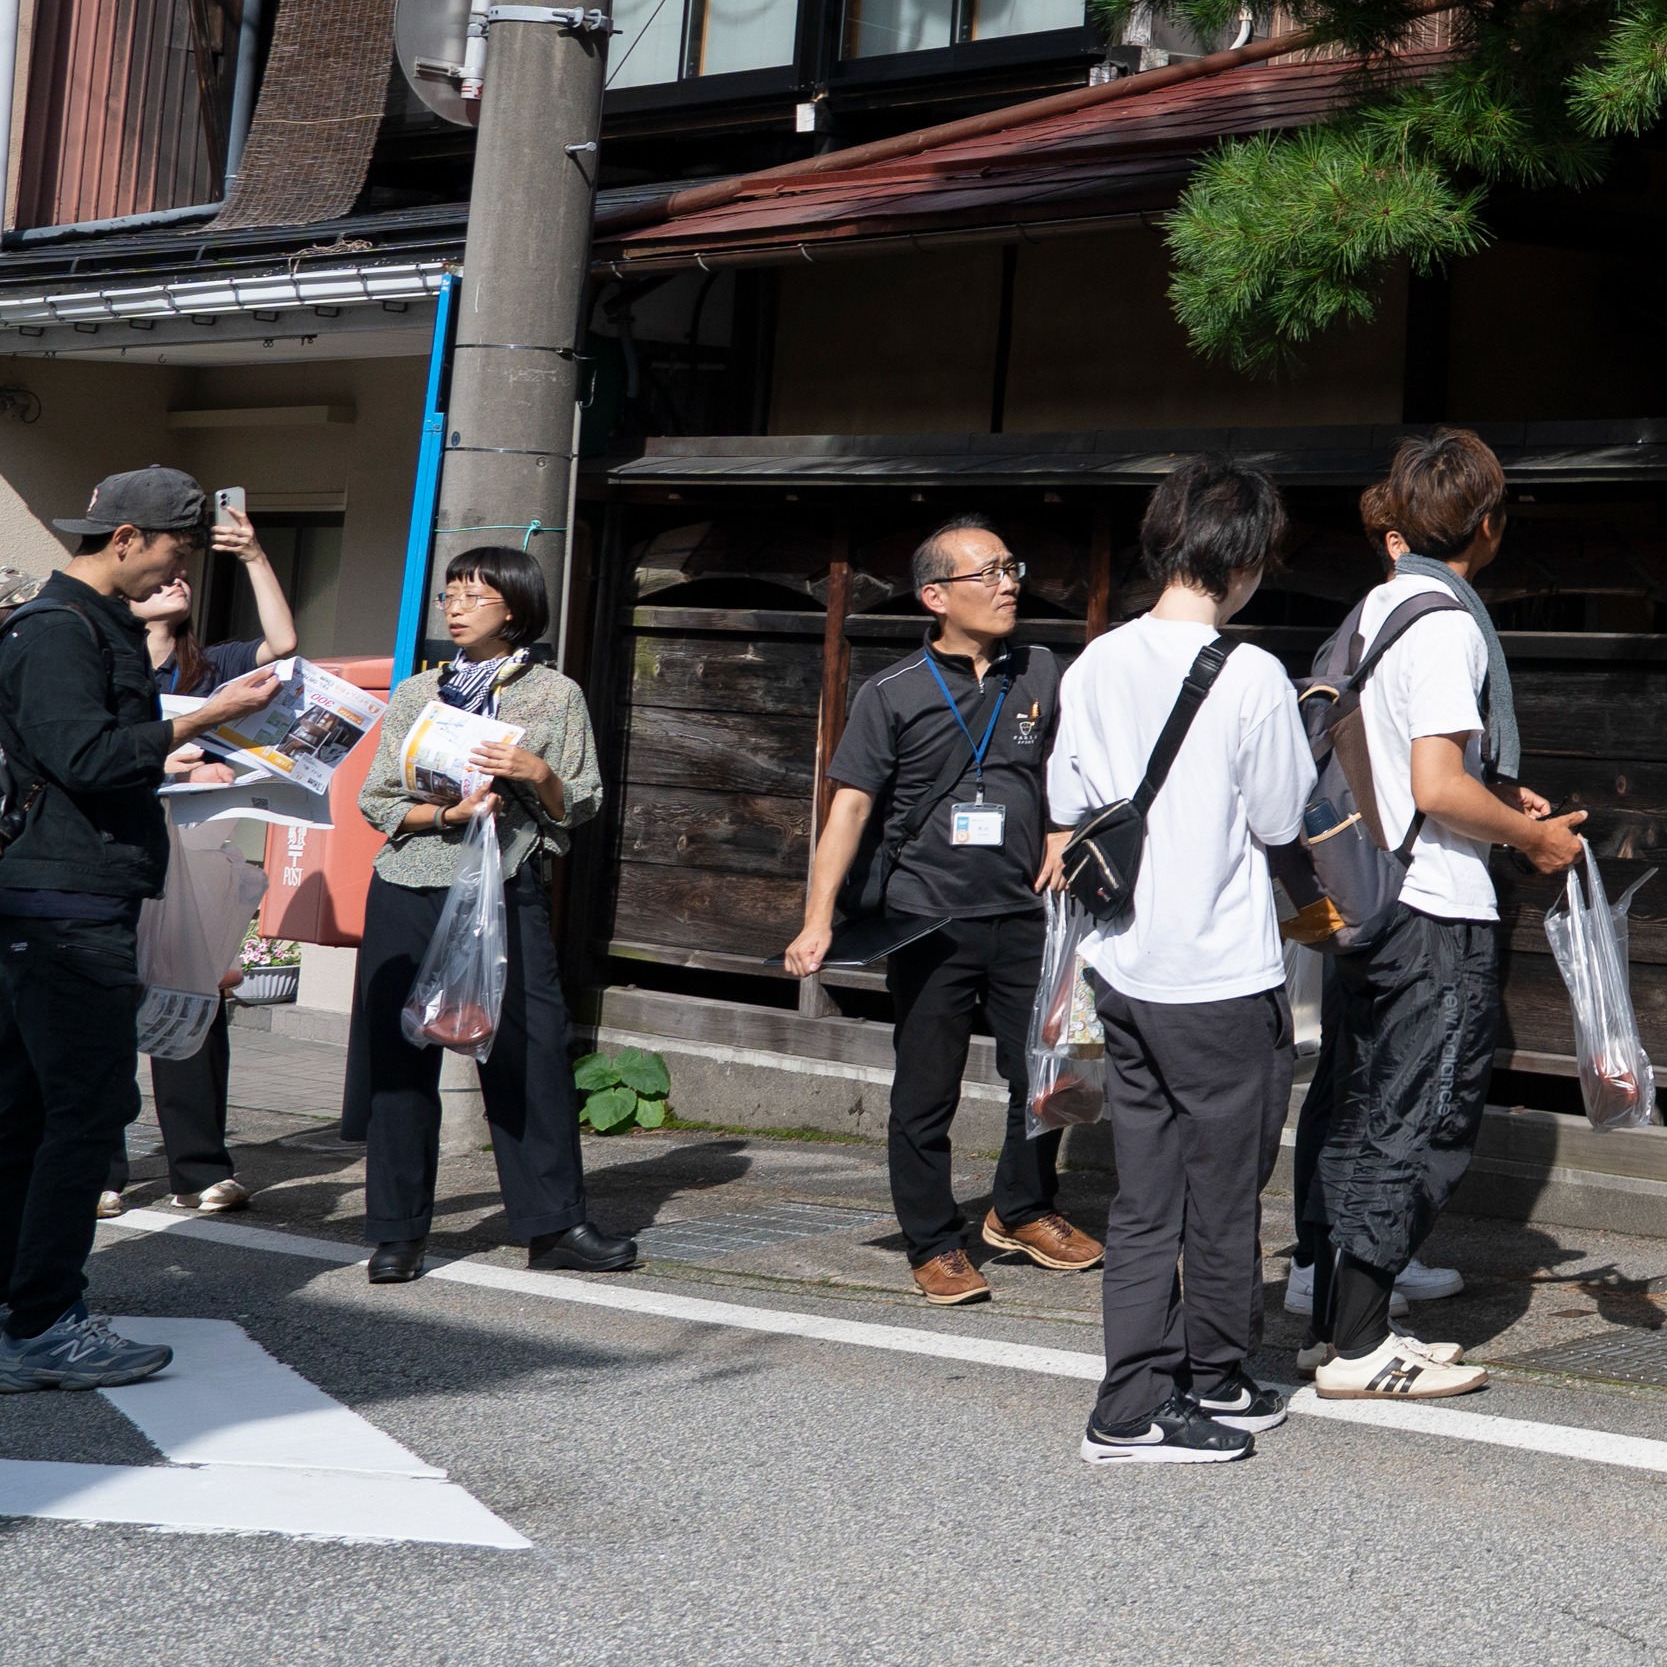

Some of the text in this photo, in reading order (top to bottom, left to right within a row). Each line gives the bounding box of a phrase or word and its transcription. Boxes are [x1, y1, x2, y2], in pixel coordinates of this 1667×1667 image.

[282, 866, 305, 887] POST
[1438, 982, 1459, 1116] new balance
